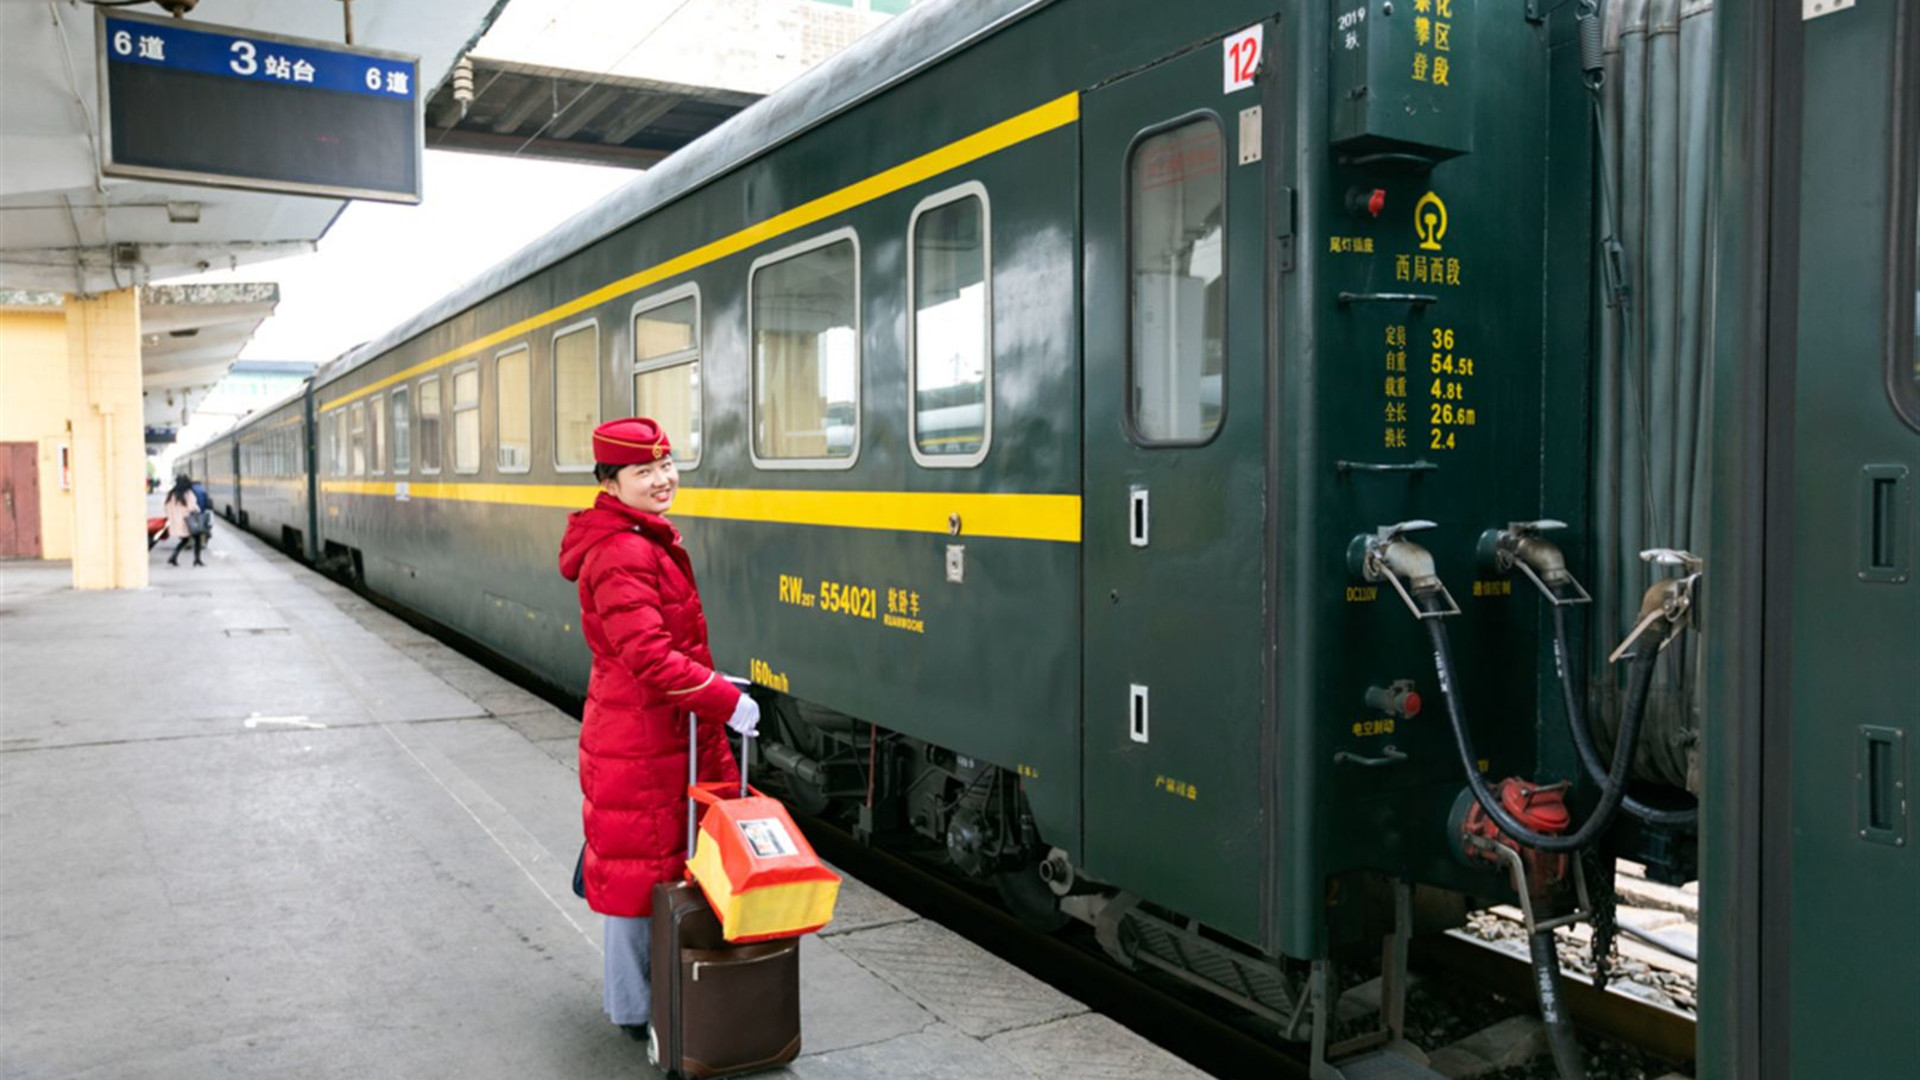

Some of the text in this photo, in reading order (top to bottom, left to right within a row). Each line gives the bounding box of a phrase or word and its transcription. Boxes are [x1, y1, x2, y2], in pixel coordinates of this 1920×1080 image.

[1338, 7, 1366, 30] 2019
[1229, 37, 1257, 83] 12
[1396, 254, 1460, 286] 西局西段
[1385, 325, 1454, 350] 定员 36
[1385, 351, 1474, 376] 自重 54.5t
[1384, 375, 1463, 400] 载重 4.8t
[1384, 401, 1476, 426] 全长 26.6m
[1384, 427, 1456, 450] 换长 2.4
[820, 581, 877, 619] 554021
[750, 658, 789, 694] 160km/h
